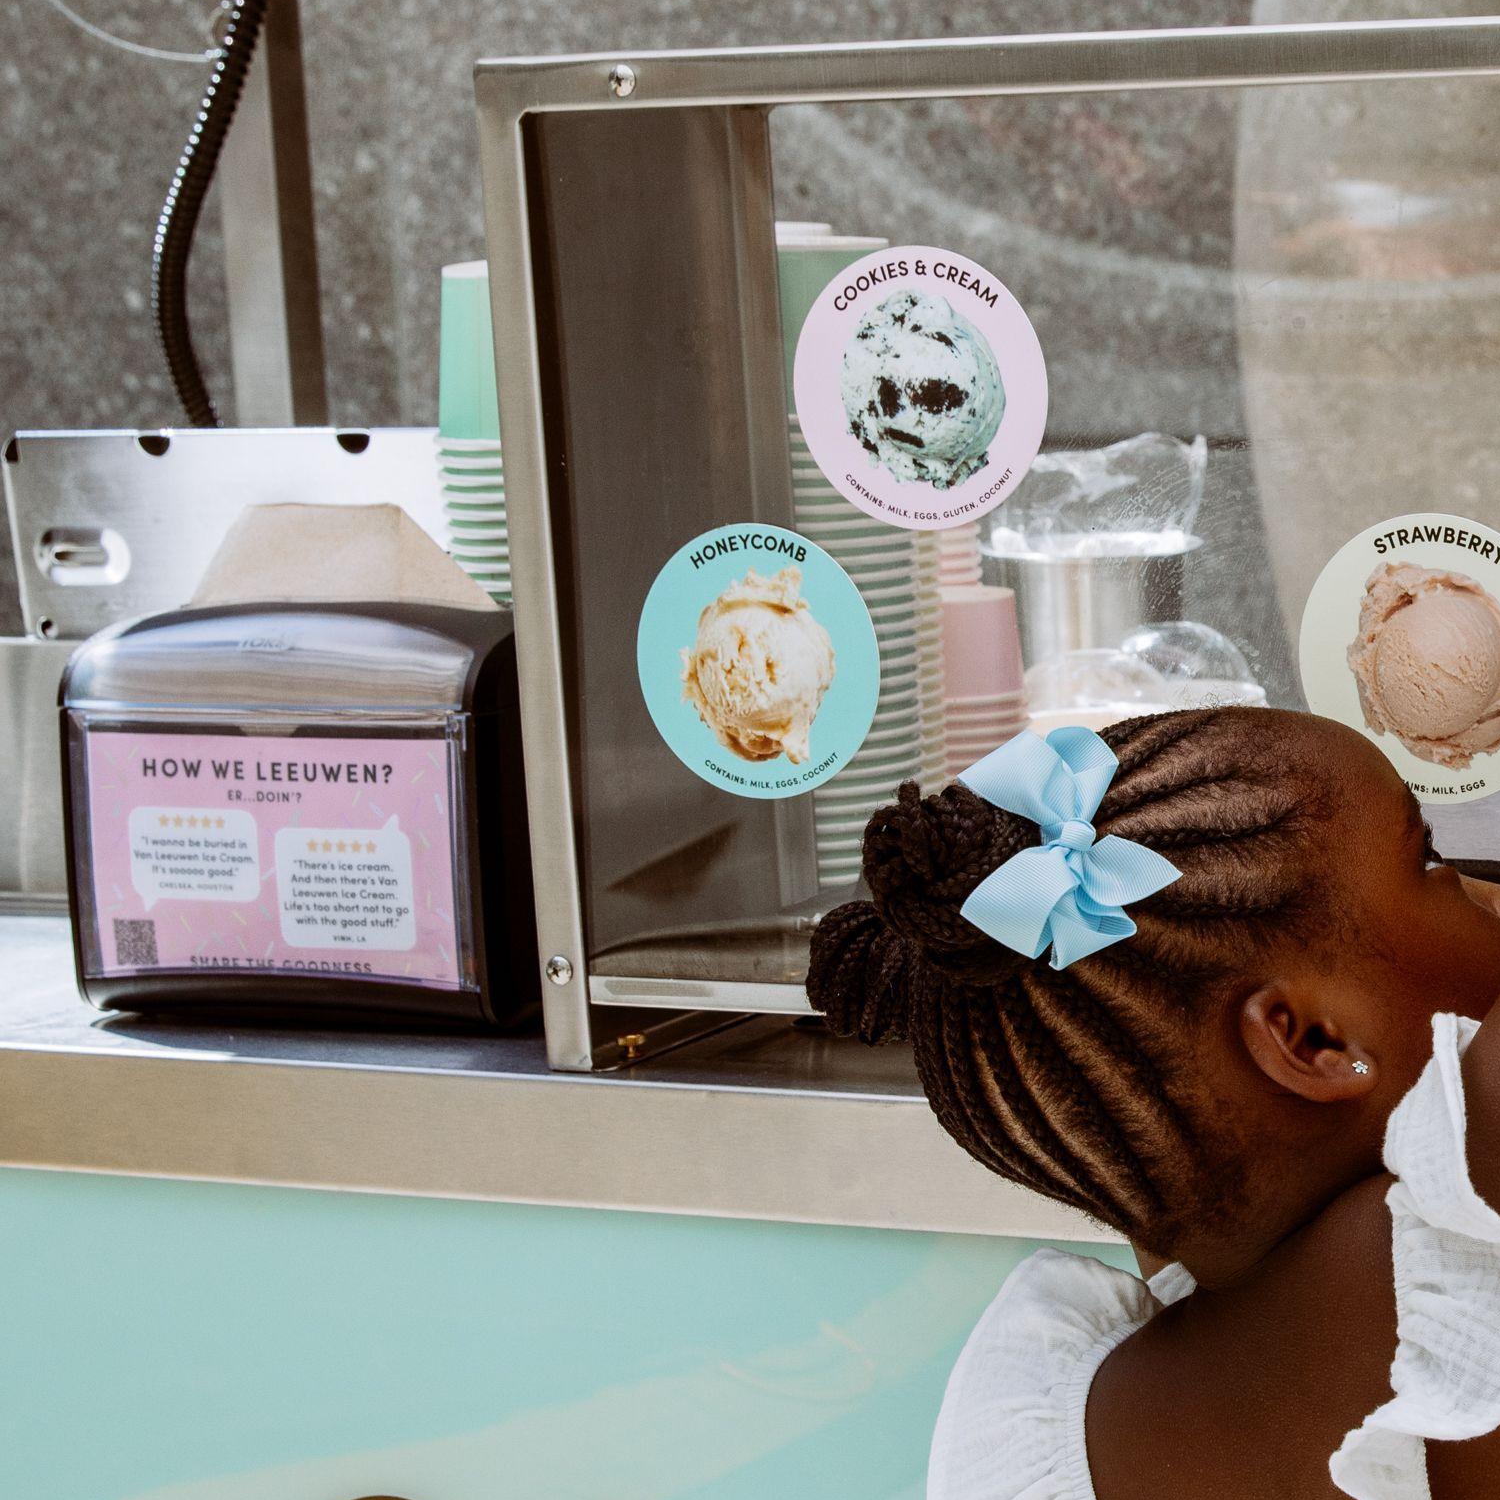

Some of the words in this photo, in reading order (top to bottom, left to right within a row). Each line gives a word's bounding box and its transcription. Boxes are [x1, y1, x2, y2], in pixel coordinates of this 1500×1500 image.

[833, 260, 909, 312] COOKIES
[914, 259, 928, 276] &
[933, 262, 1000, 309] CREAM
[845, 472, 887, 510] CONTAINS:
[888, 504, 912, 520] MILK,
[913, 511, 942, 521] EGGS,
[942, 501, 979, 520] GLUTEN,
[978, 467, 1014, 505] COCONUT
[690, 533, 808, 570] HONEYCOMB
[142, 758, 202, 779] HOW
[211, 759, 245, 780] WE
[256, 761, 394, 784] LEEUWEN?
[704, 759, 748, 787] CONTAINS:
[750, 780, 774, 790] MILK,
[776, 778, 802, 789] EGGS,
[802, 752, 840, 782] COCONUT
[1431, 786, 1458, 795] MILK,
[1460, 779, 1486, 793] EGGS
[151, 838, 185, 848] wanna
[188, 838, 201, 848] be
[203, 838, 236, 849] buried
[238, 839, 248, 849] in
[133, 850, 151, 860] Van
[154, 851, 199, 862] Leeuwen
[202, 852, 217, 863] Ice
[338, 861, 354, 872] ice
[290, 874, 312, 884] And
[314, 875, 337, 885] then
[378, 876, 398, 887] Van
[291, 888, 338, 899] Leeuwen
[341, 889, 357, 900] Ice
[313, 902, 330, 913] too
[333, 903, 360, 914] short
[362, 904, 380, 914] not
[381, 904, 393, 915] to
[395, 906, 410, 917] go
[295, 915, 318, 926] with
[320, 916, 337, 926] the
[340, 917, 368, 929] good
